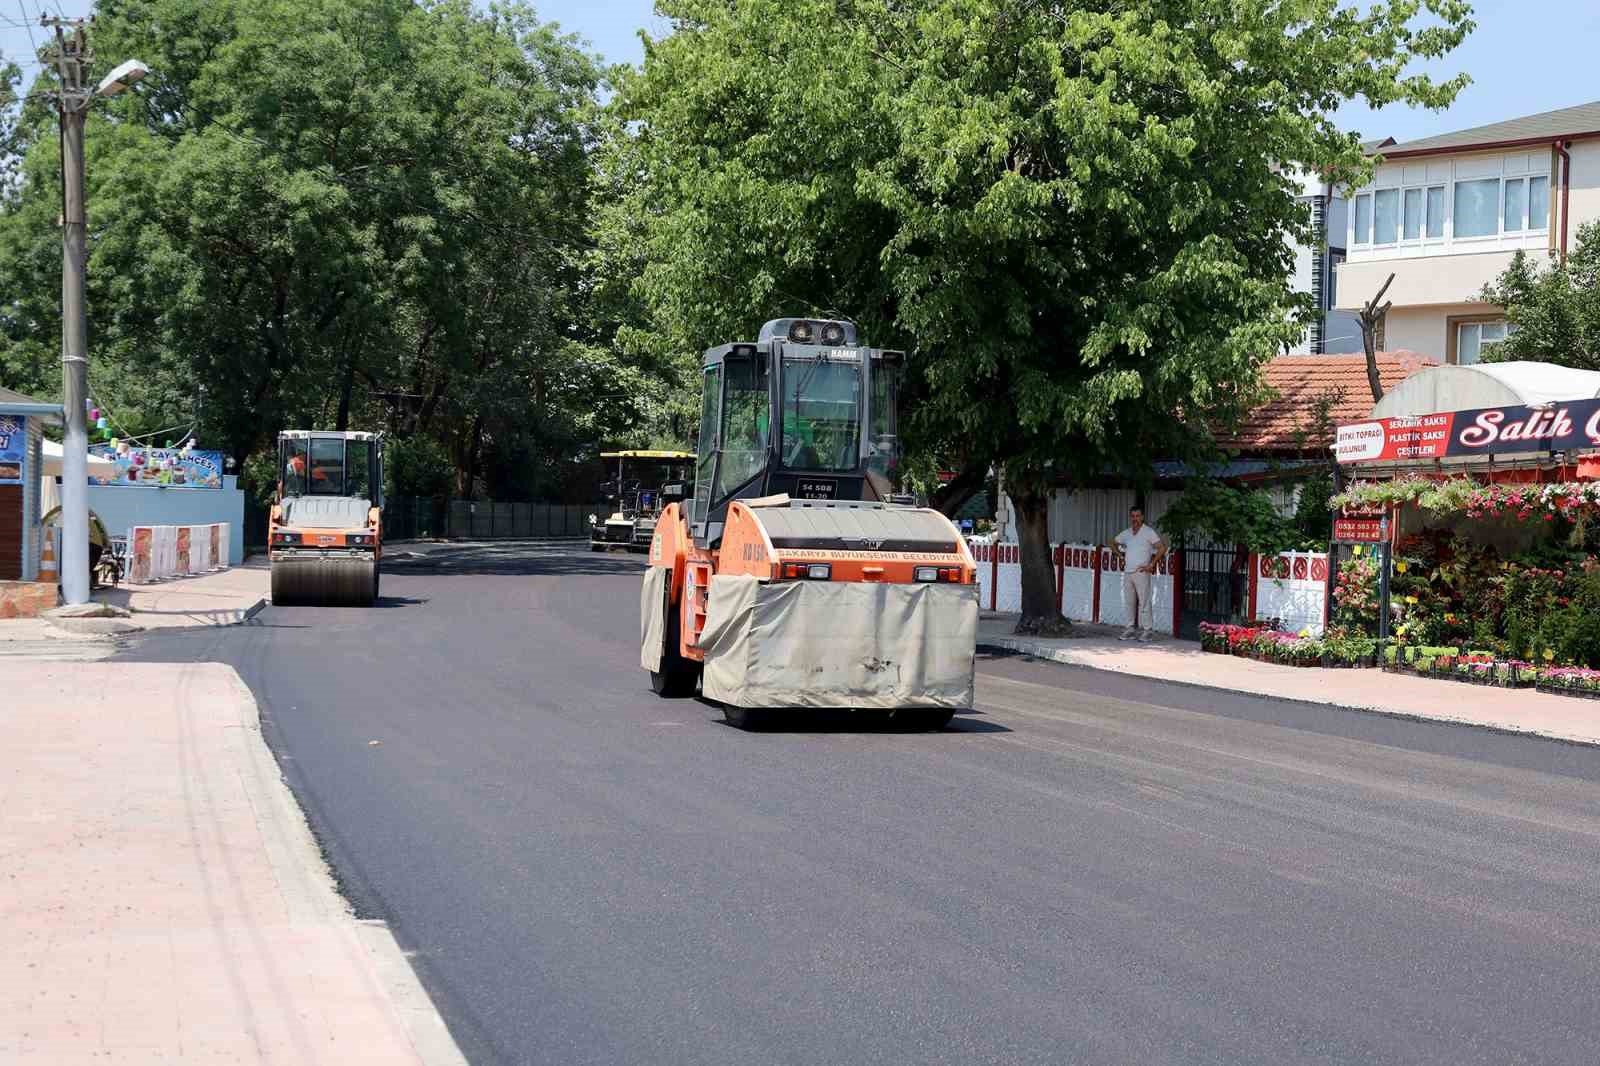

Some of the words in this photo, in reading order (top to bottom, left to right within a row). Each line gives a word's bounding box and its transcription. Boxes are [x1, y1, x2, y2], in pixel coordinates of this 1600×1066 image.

[1423, 416, 1447, 426] SAKSI
[1459, 408, 1574, 447] Salih
[1389, 431, 1421, 443] PLASTİK
[1422, 430, 1446, 441] SAKSI
[1396, 444, 1436, 458] ÇEŞİTLERİ
